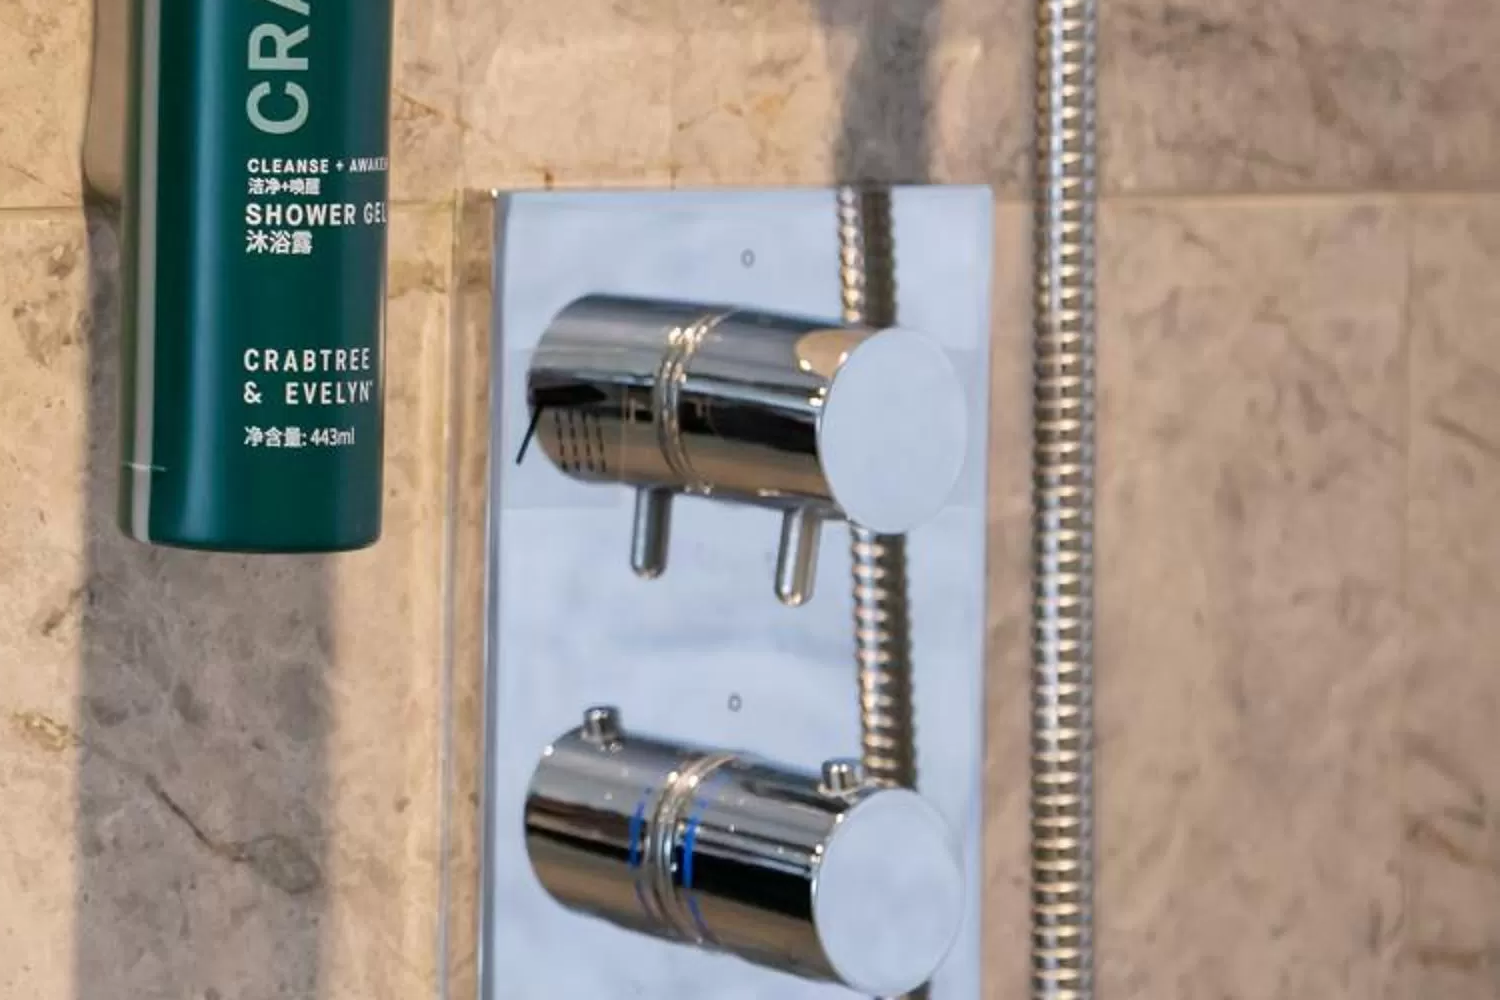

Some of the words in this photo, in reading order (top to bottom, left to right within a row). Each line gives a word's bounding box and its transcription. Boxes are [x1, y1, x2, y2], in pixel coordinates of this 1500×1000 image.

[247, 158, 329, 174] CLEANSE
[245, 203, 356, 226] SHOWER
[363, 202, 387, 224] GEL
[245, 229, 313, 255] 沐浴露
[243, 348, 370, 372] CRABTREE
[243, 380, 262, 404] &
